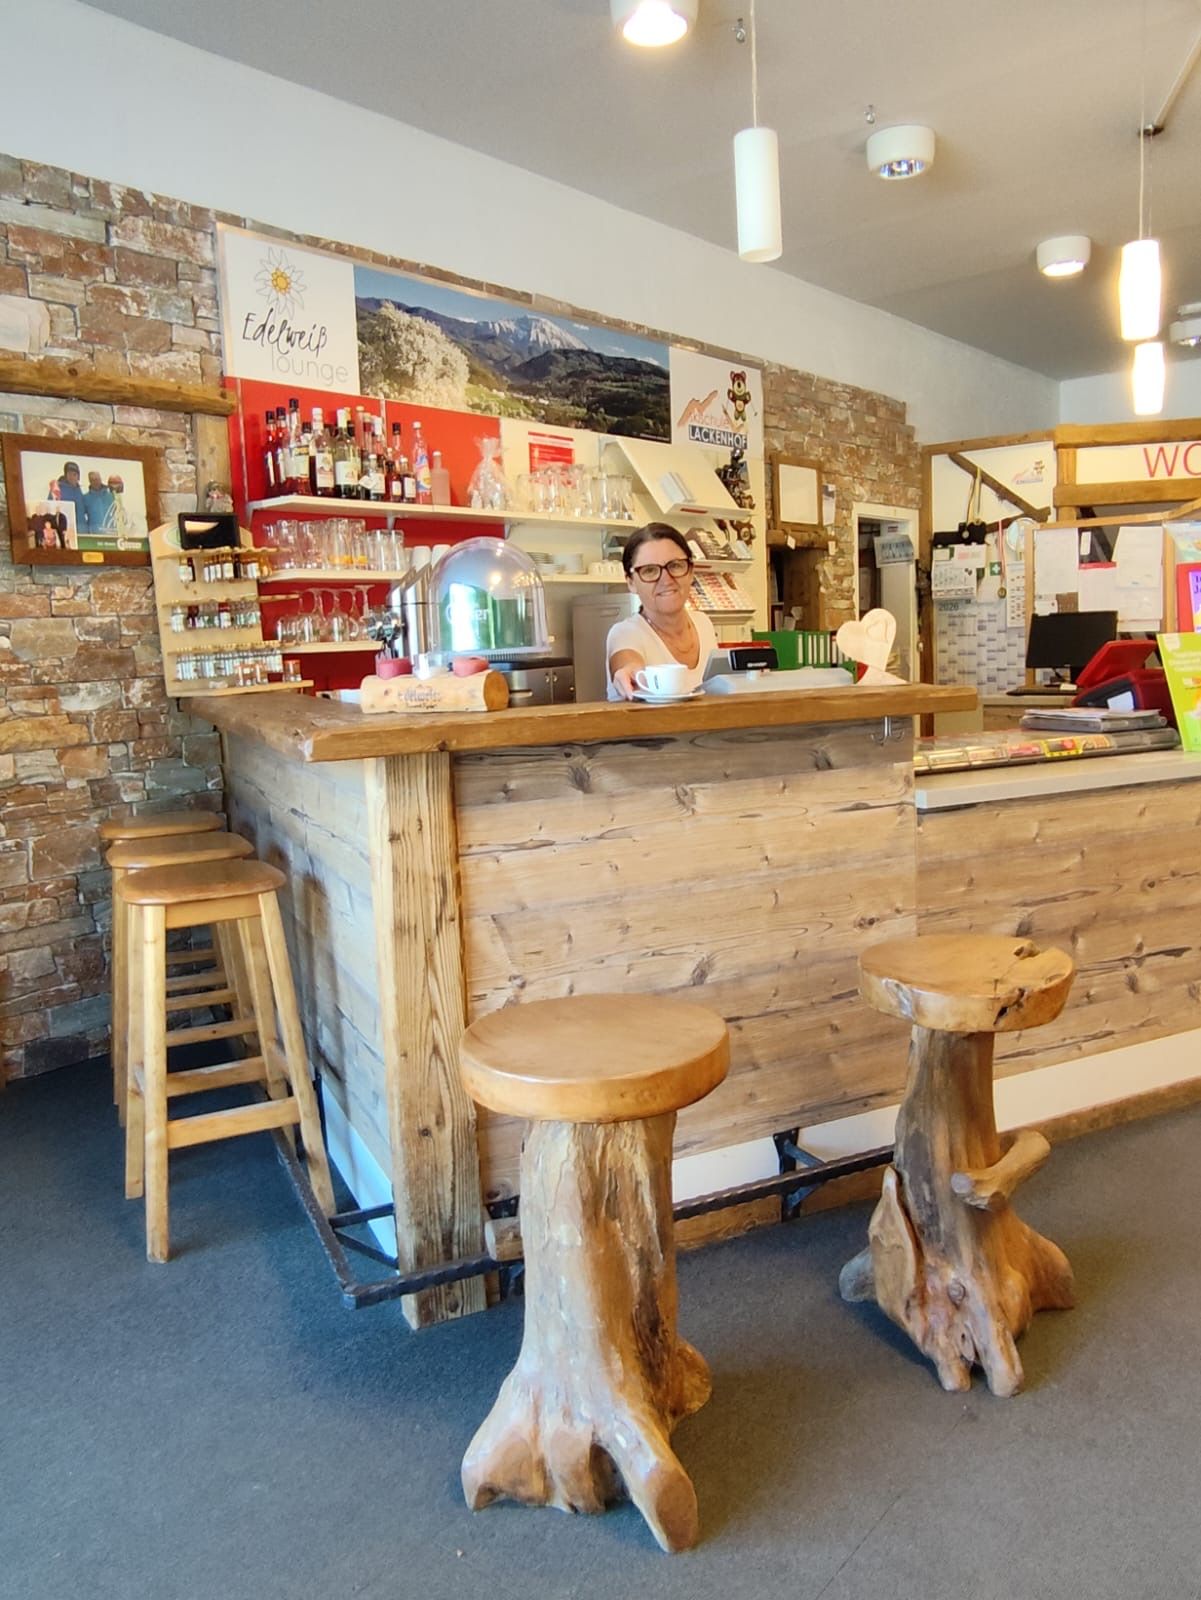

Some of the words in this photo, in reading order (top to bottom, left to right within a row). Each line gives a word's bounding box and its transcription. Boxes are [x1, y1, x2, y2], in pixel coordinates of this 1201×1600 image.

[242, 307, 327, 358] Edelweiß
[271, 343, 348, 387] lounge
[690, 424, 746, 448] LACKENHOF
